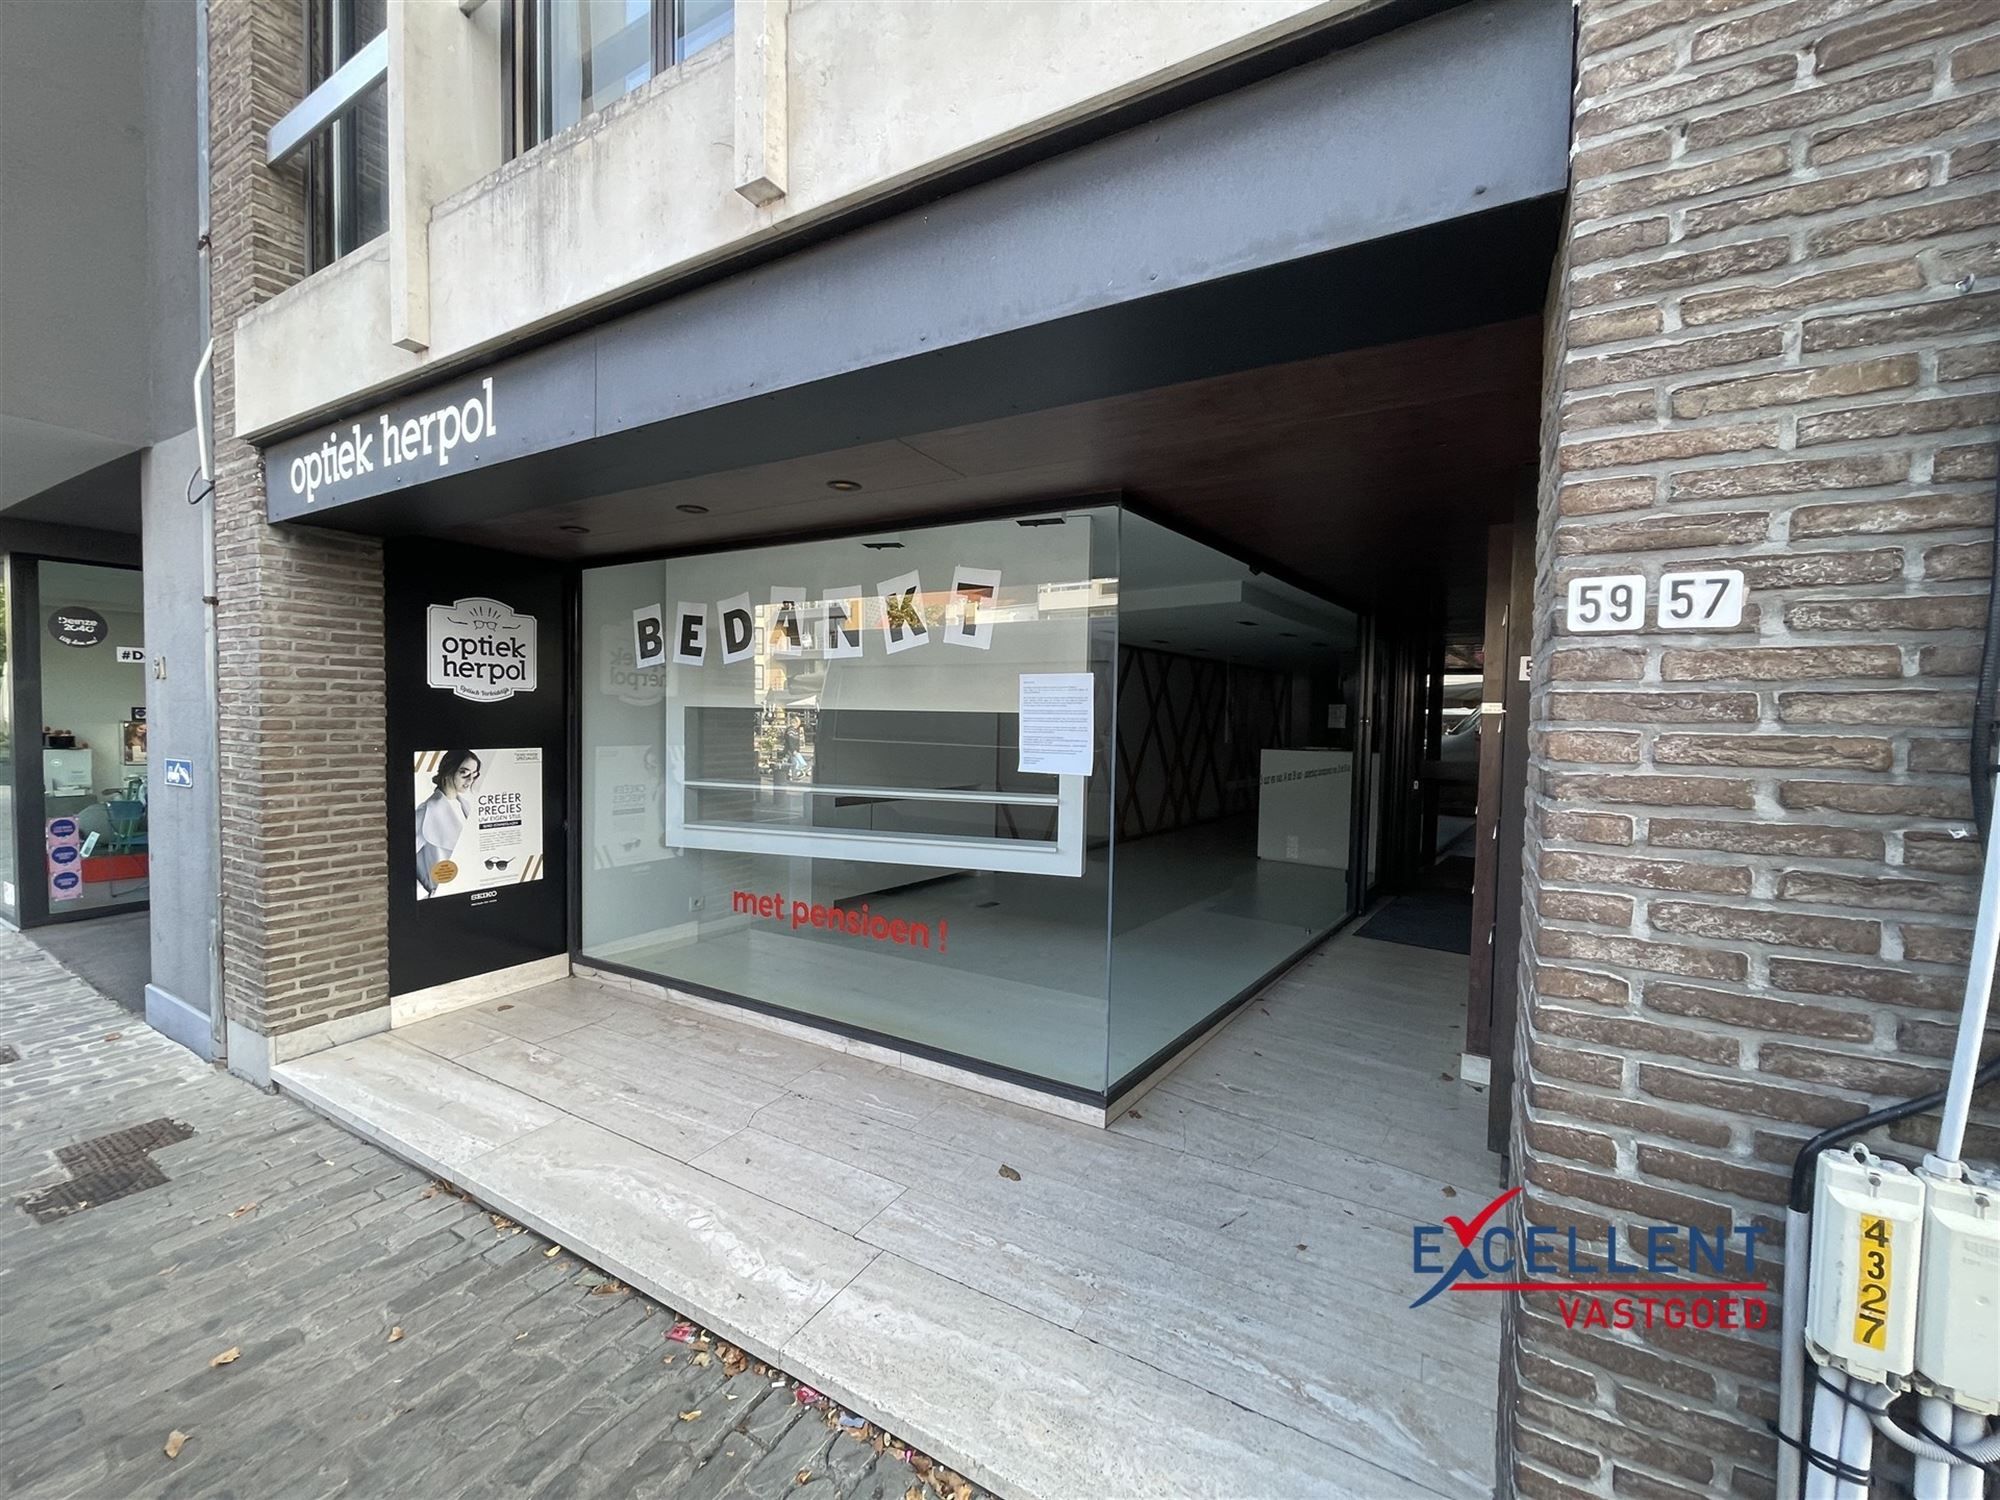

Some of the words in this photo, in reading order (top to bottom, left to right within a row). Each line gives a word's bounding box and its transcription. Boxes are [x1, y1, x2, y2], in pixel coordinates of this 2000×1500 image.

[290, 424, 374, 503] optiek
[380, 377, 496, 466] herpol
[1579, 584, 1633, 623] 59
[1671, 578, 1731, 619] 57
[64, 624, 95, 633] 2040
[637, 582, 994, 660] BEDANKT
[442, 635, 526, 660] optiek
[442, 655, 526, 685] herpol
[478, 791, 521, 805] CREËER
[478, 803, 522, 816] PRECIES
[470, 890, 498, 900] SEIKO
[732, 888, 785, 920] met
[792, 899, 930, 949] pensioen
[938, 919, 949, 953] !
[1859, 1219, 1889, 1344] 4327
